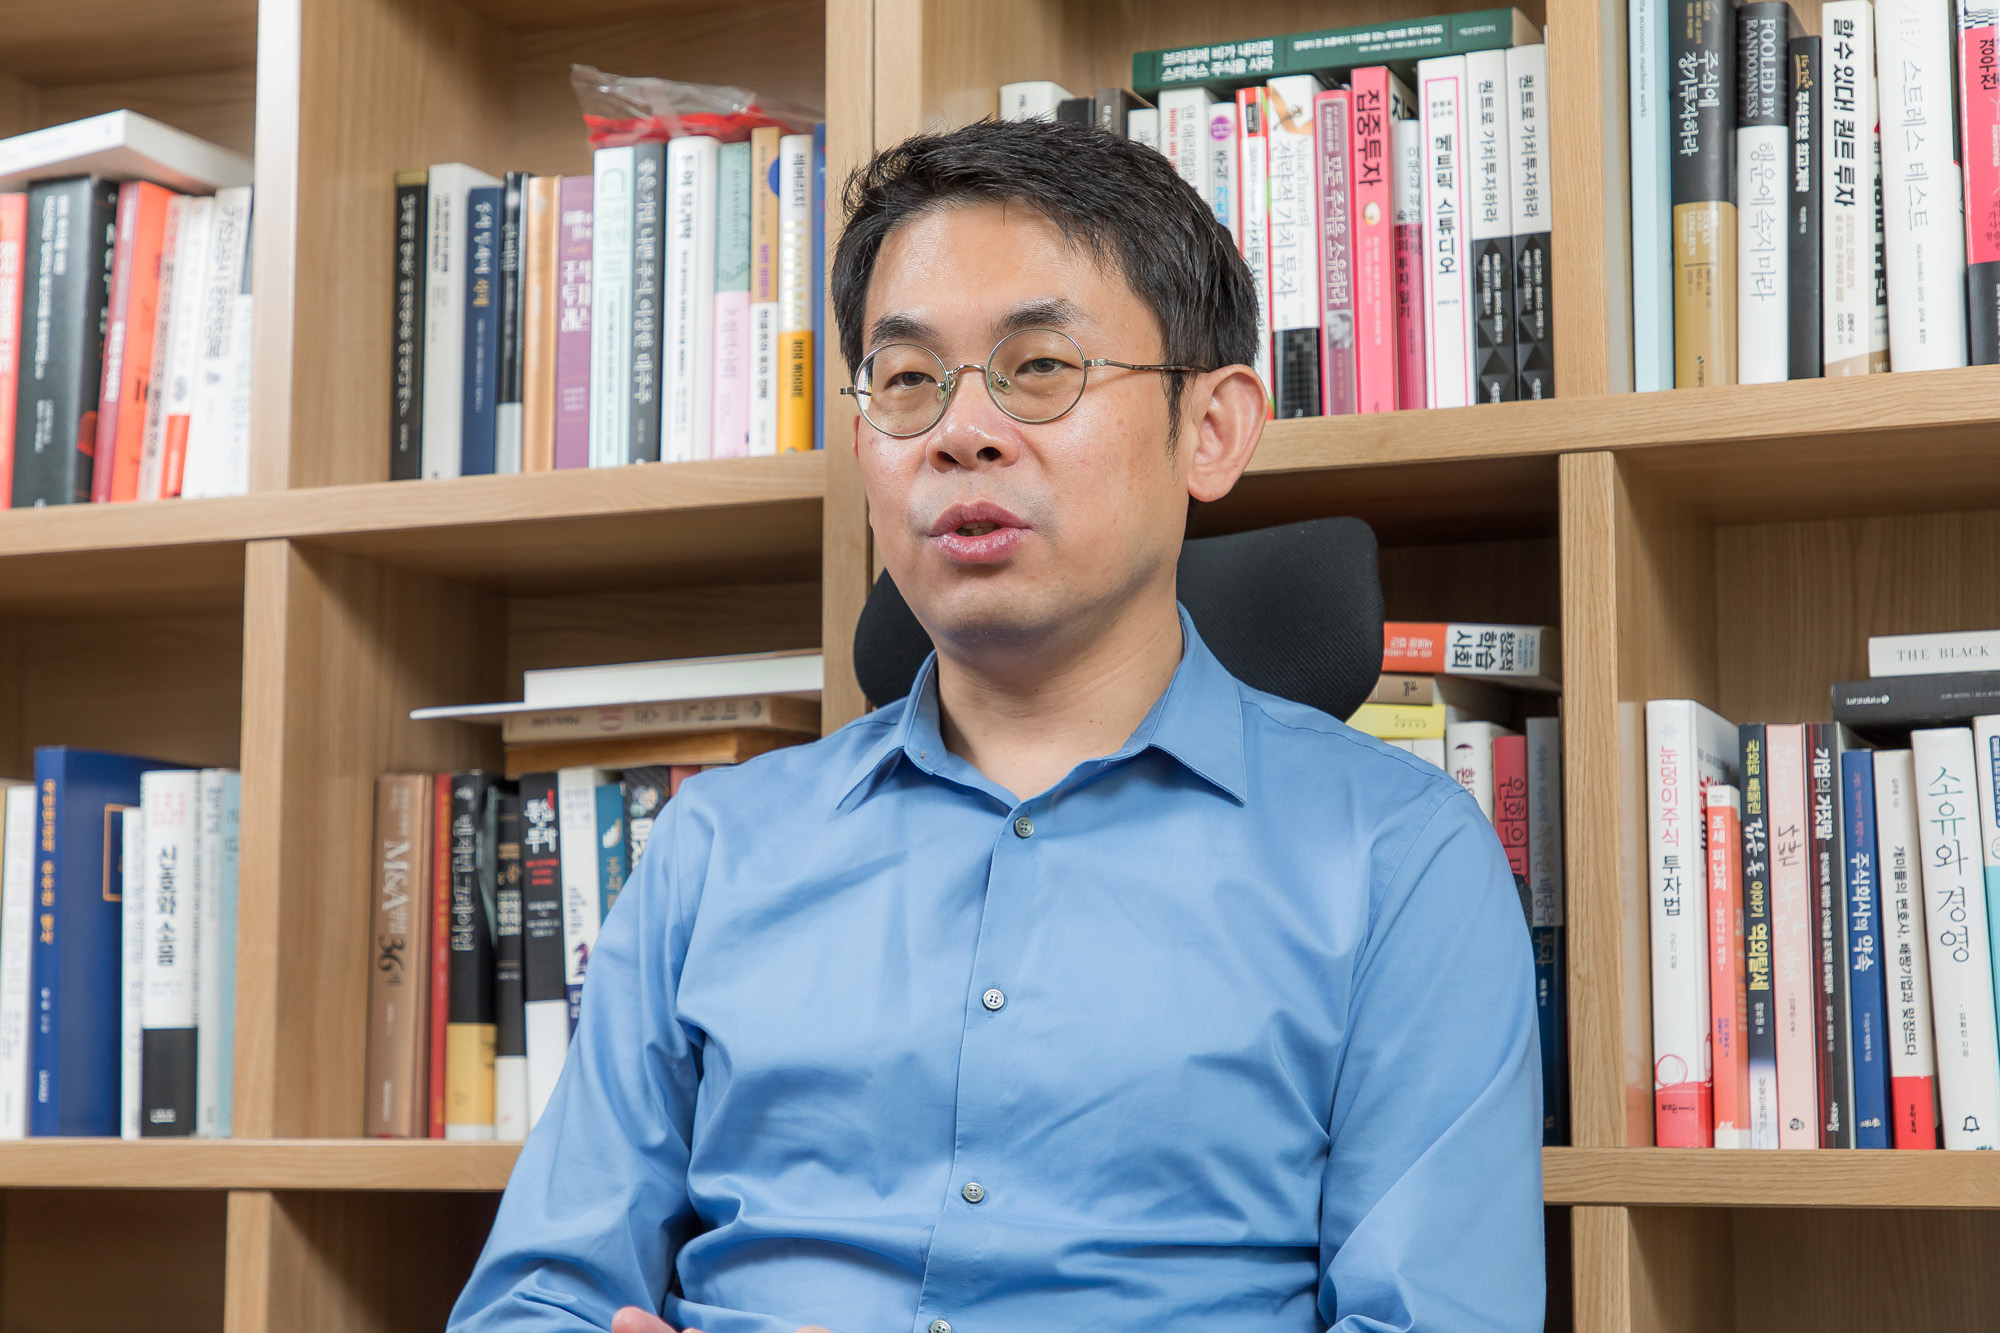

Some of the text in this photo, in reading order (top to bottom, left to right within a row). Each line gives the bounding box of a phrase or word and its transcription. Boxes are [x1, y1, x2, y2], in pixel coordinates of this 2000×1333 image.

[1161, 40, 1274, 67] 브라질에 비가 내리면
[1161, 55, 1274, 82] 스타벅스 주식을 사라
[1697, 49, 1720, 108] 주식에
[1746, 19, 1760, 118] RANDOMNESS
[1760, 18, 1776, 118] FOOLED BY
[1181, 104, 1196, 120] 댄
[1678, 51, 1700, 157] 장기투자하라
[1796, 91, 1810, 141] 주식초보
[1834, 18, 1856, 207] 할 수 있다! 퀀트 투자
[1214, 149, 1229, 180] 주식
[1357, 89, 1383, 187] 집중투자
[1478, 79, 1499, 224] 퀀트로 가치투자하라
[1518, 74, 1540, 219] 퀀트로 가치투자하라
[1900, 59, 1929, 232] 스트레스 테스트
[792, 152, 807, 208] 레버리지
[1324, 155, 1344, 188] 모든
[1273, 140, 1297, 299] 전략적 가치 투자
[1325, 190, 1346, 239] 주식을
[1435, 133, 1457, 276] 메트릭 스튜디오
[1750, 141, 1777, 301] 행운에 속지 마라
[635, 228, 656, 261] 나쁜
[1327, 241, 1348, 307] 소유하라
[633, 300, 655, 349] 이상한
[792, 339, 805, 361] ROB
[632, 353, 653, 405] 대주주
[1452, 629, 1473, 669] 사회
[1475, 631, 1497, 671] 학습
[1499, 631, 1515, 672] 창조적
[1896, 645, 1990, 662] THE BLACK
[1812, 747, 1833, 840] 기업의 거짓말
[381, 840, 411, 911] M&A
[1711, 814, 1727, 891] 조세 피난처
[1744, 738, 1770, 991] 국외로 빼돌린 검은 돈 이야기 역외탈세
[1776, 824, 1803, 868] 나쁜
[1927, 765, 1970, 963] 소유와 경영
[156, 844, 178, 917] 신호와
[451, 813, 476, 951] 벤저민 그레이엄
[1535, 877, 1555, 927] 배당주
[1662, 854, 1683, 917] 투자법
[1851, 851, 1873, 972] 주식회사의 약속
[1533, 932, 1555, 967] 투자
[1893, 845, 1918, 1057] 개미들의 변호사, 배짱기업과 맞장뜨다
